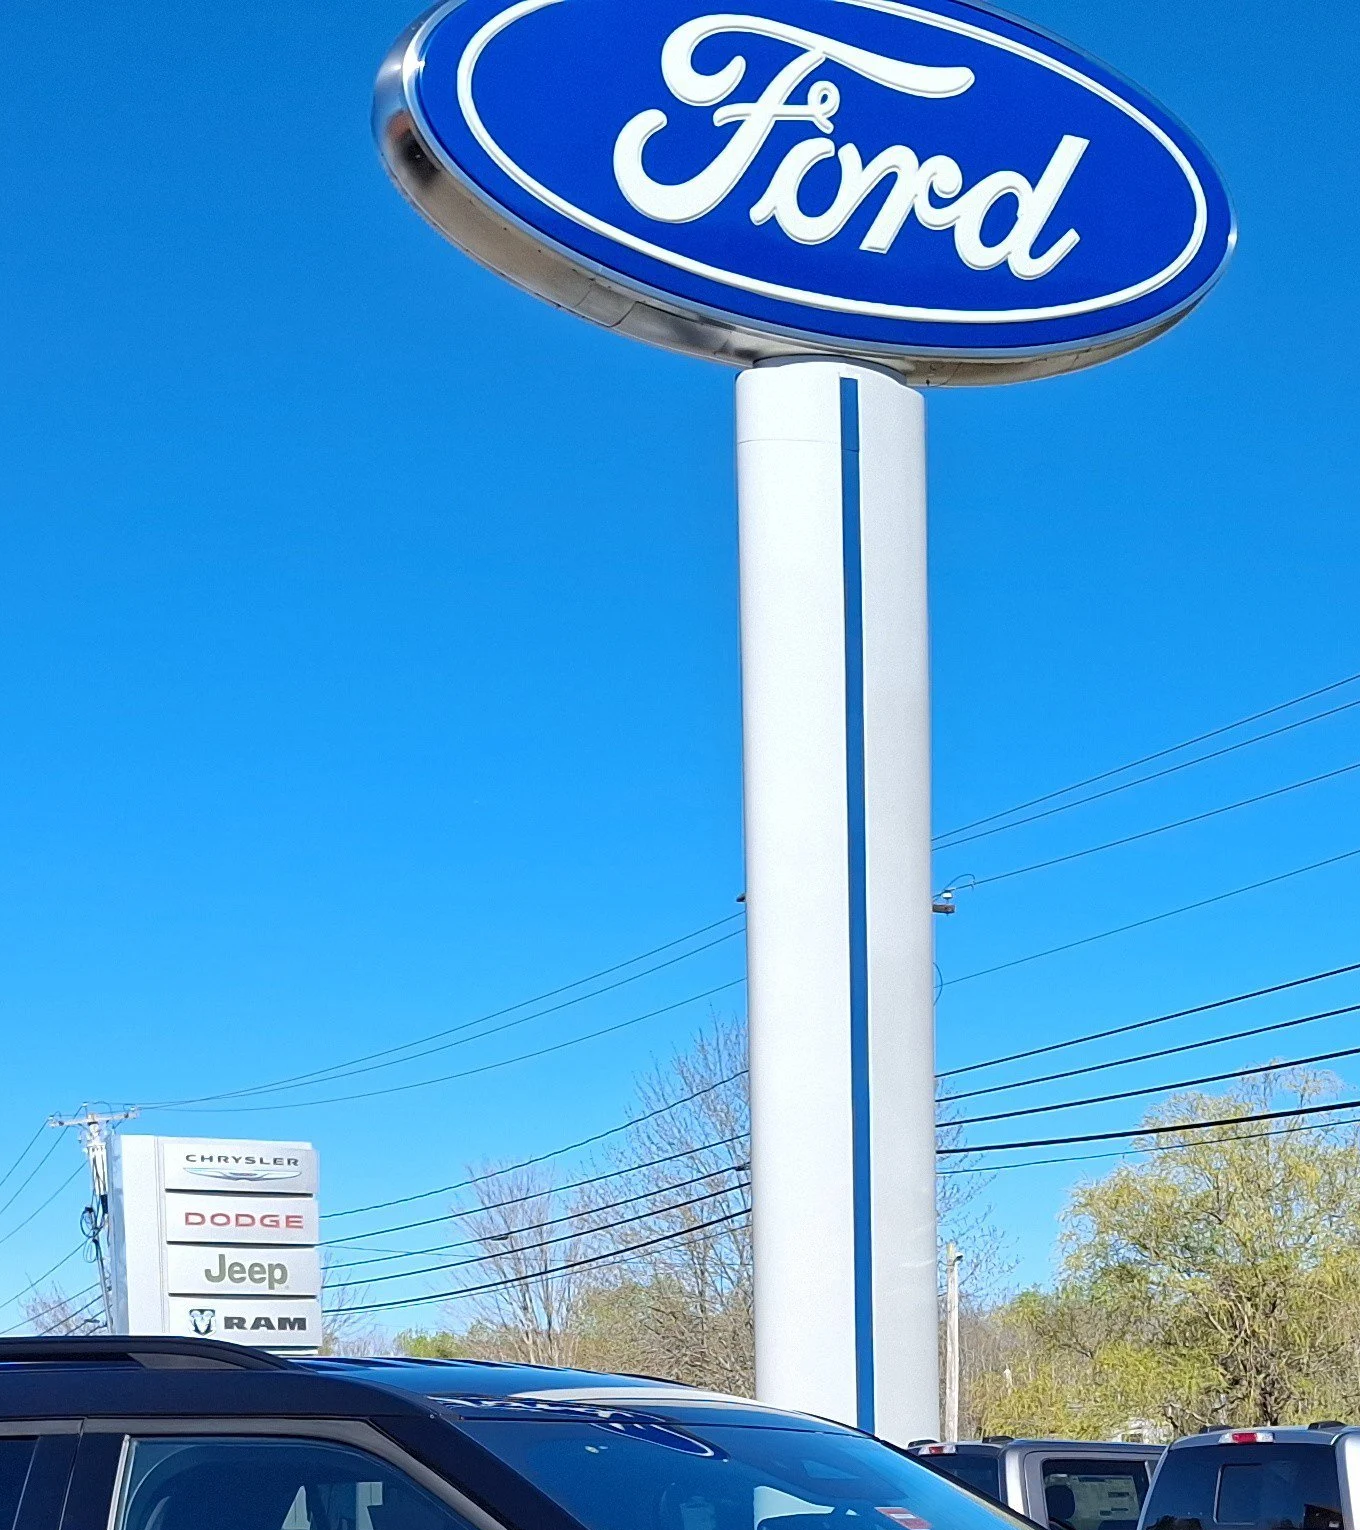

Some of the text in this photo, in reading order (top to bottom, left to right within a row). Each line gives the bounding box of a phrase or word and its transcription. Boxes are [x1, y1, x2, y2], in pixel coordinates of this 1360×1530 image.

[613, 13, 1090, 281] Ford
[185, 1153, 300, 1167] CHRYSLER
[184, 1212, 304, 1230] DODGE
[204, 1254, 289, 1290] Jeep
[223, 1315, 307, 1331] RAM
